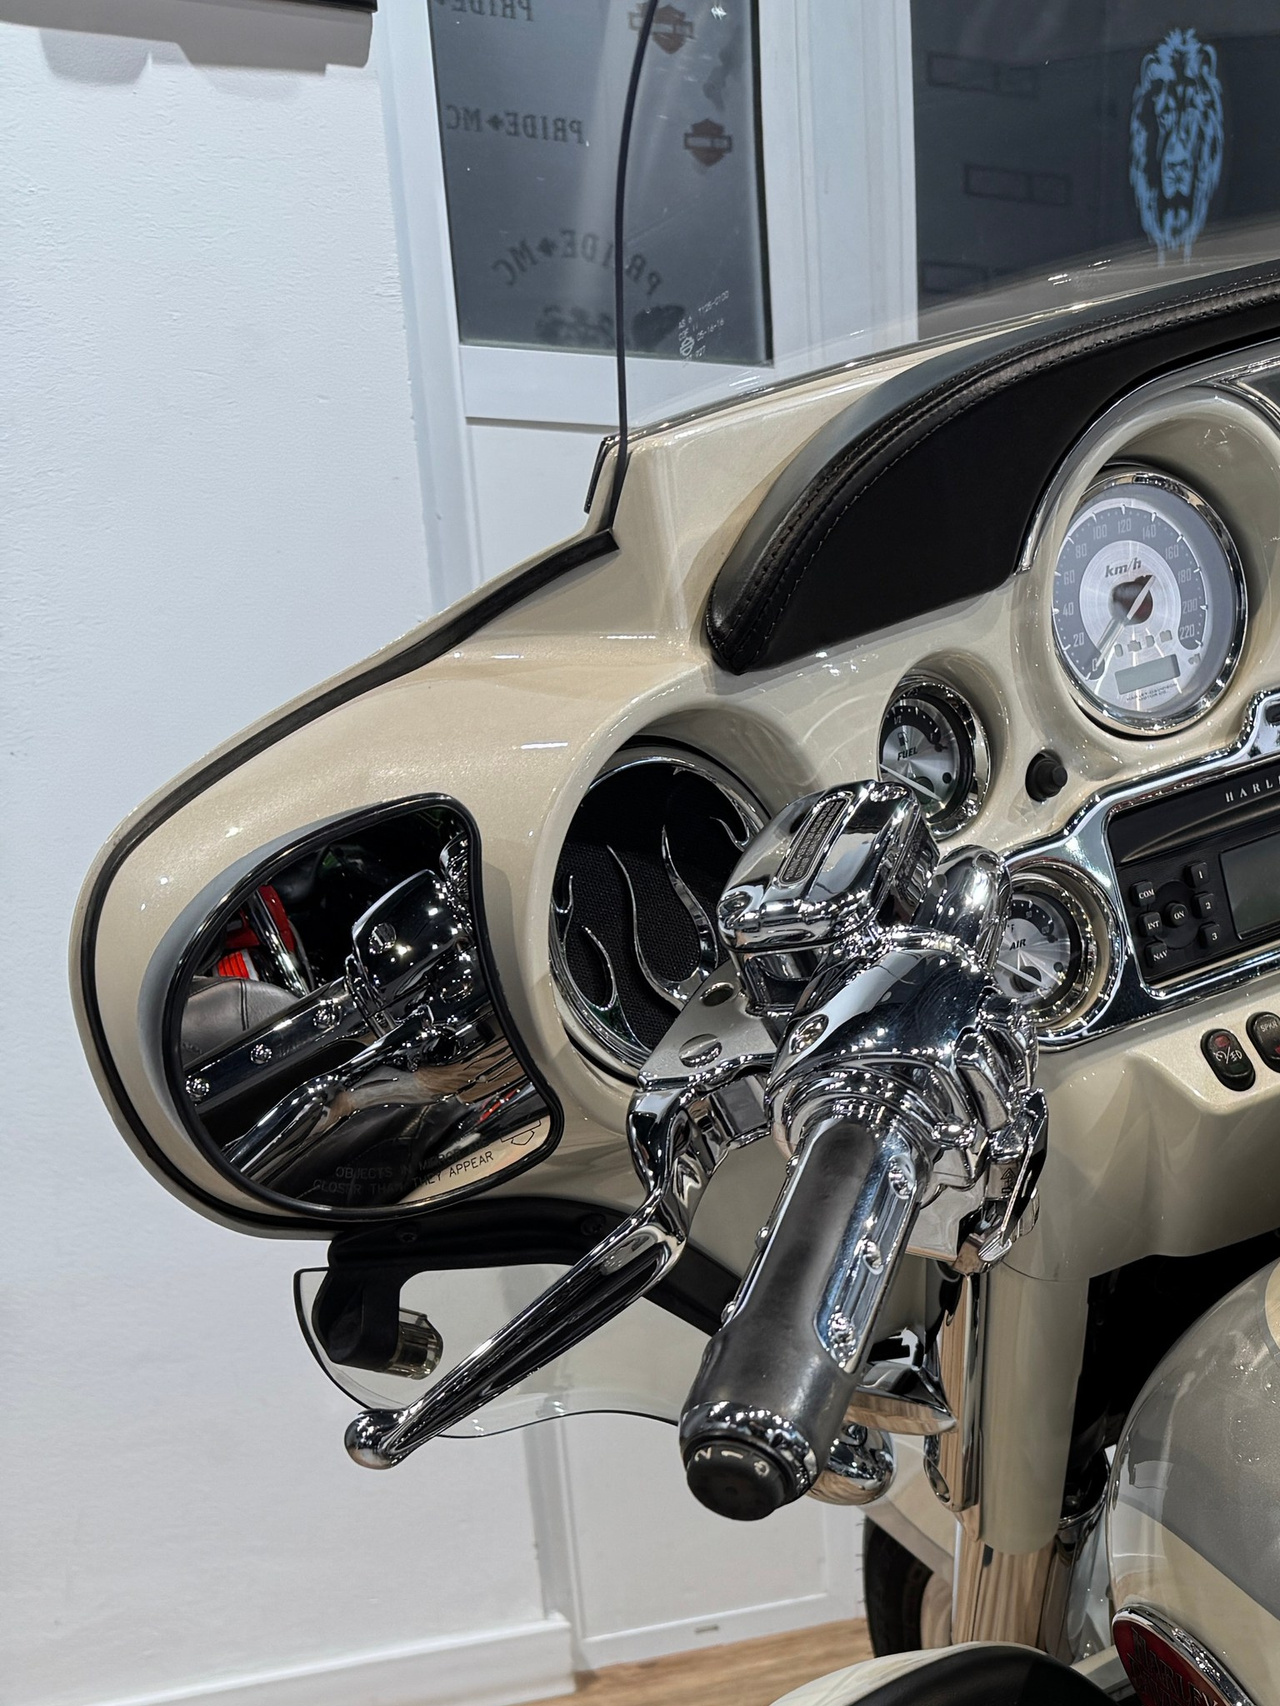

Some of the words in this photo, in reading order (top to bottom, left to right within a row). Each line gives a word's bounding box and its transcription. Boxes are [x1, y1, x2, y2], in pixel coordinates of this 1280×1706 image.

[1092, 525, 1108, 540] 100
[1117, 519, 1132, 533] 120
[1142, 524, 1157, 538] 140
[1075, 544, 1088, 558] 80
[1165, 545, 1180, 560] 160
[1105, 557, 1142, 578] km/h
[1064, 570, 1075, 585] 60
[1177, 568, 1192, 583] 180
[1062, 602, 1074, 616] 40
[1182, 598, 1198, 614] 200
[1073, 632, 1085, 646] 20
[1179, 625, 1195, 640] 220
[897, 747, 918, 761] FUEL
[1138, 888, 1155, 900] COM
[1205, 902, 1212, 910] 2
[1173, 911, 1185, 920] ON
[1147, 920, 1160, 930] INT
[1212, 932, 1218, 941] 3
[1009, 938, 1027, 951] AIR
[1153, 950, 1168, 962] NAV
[448, 1151, 495, 1178] APPEAR
